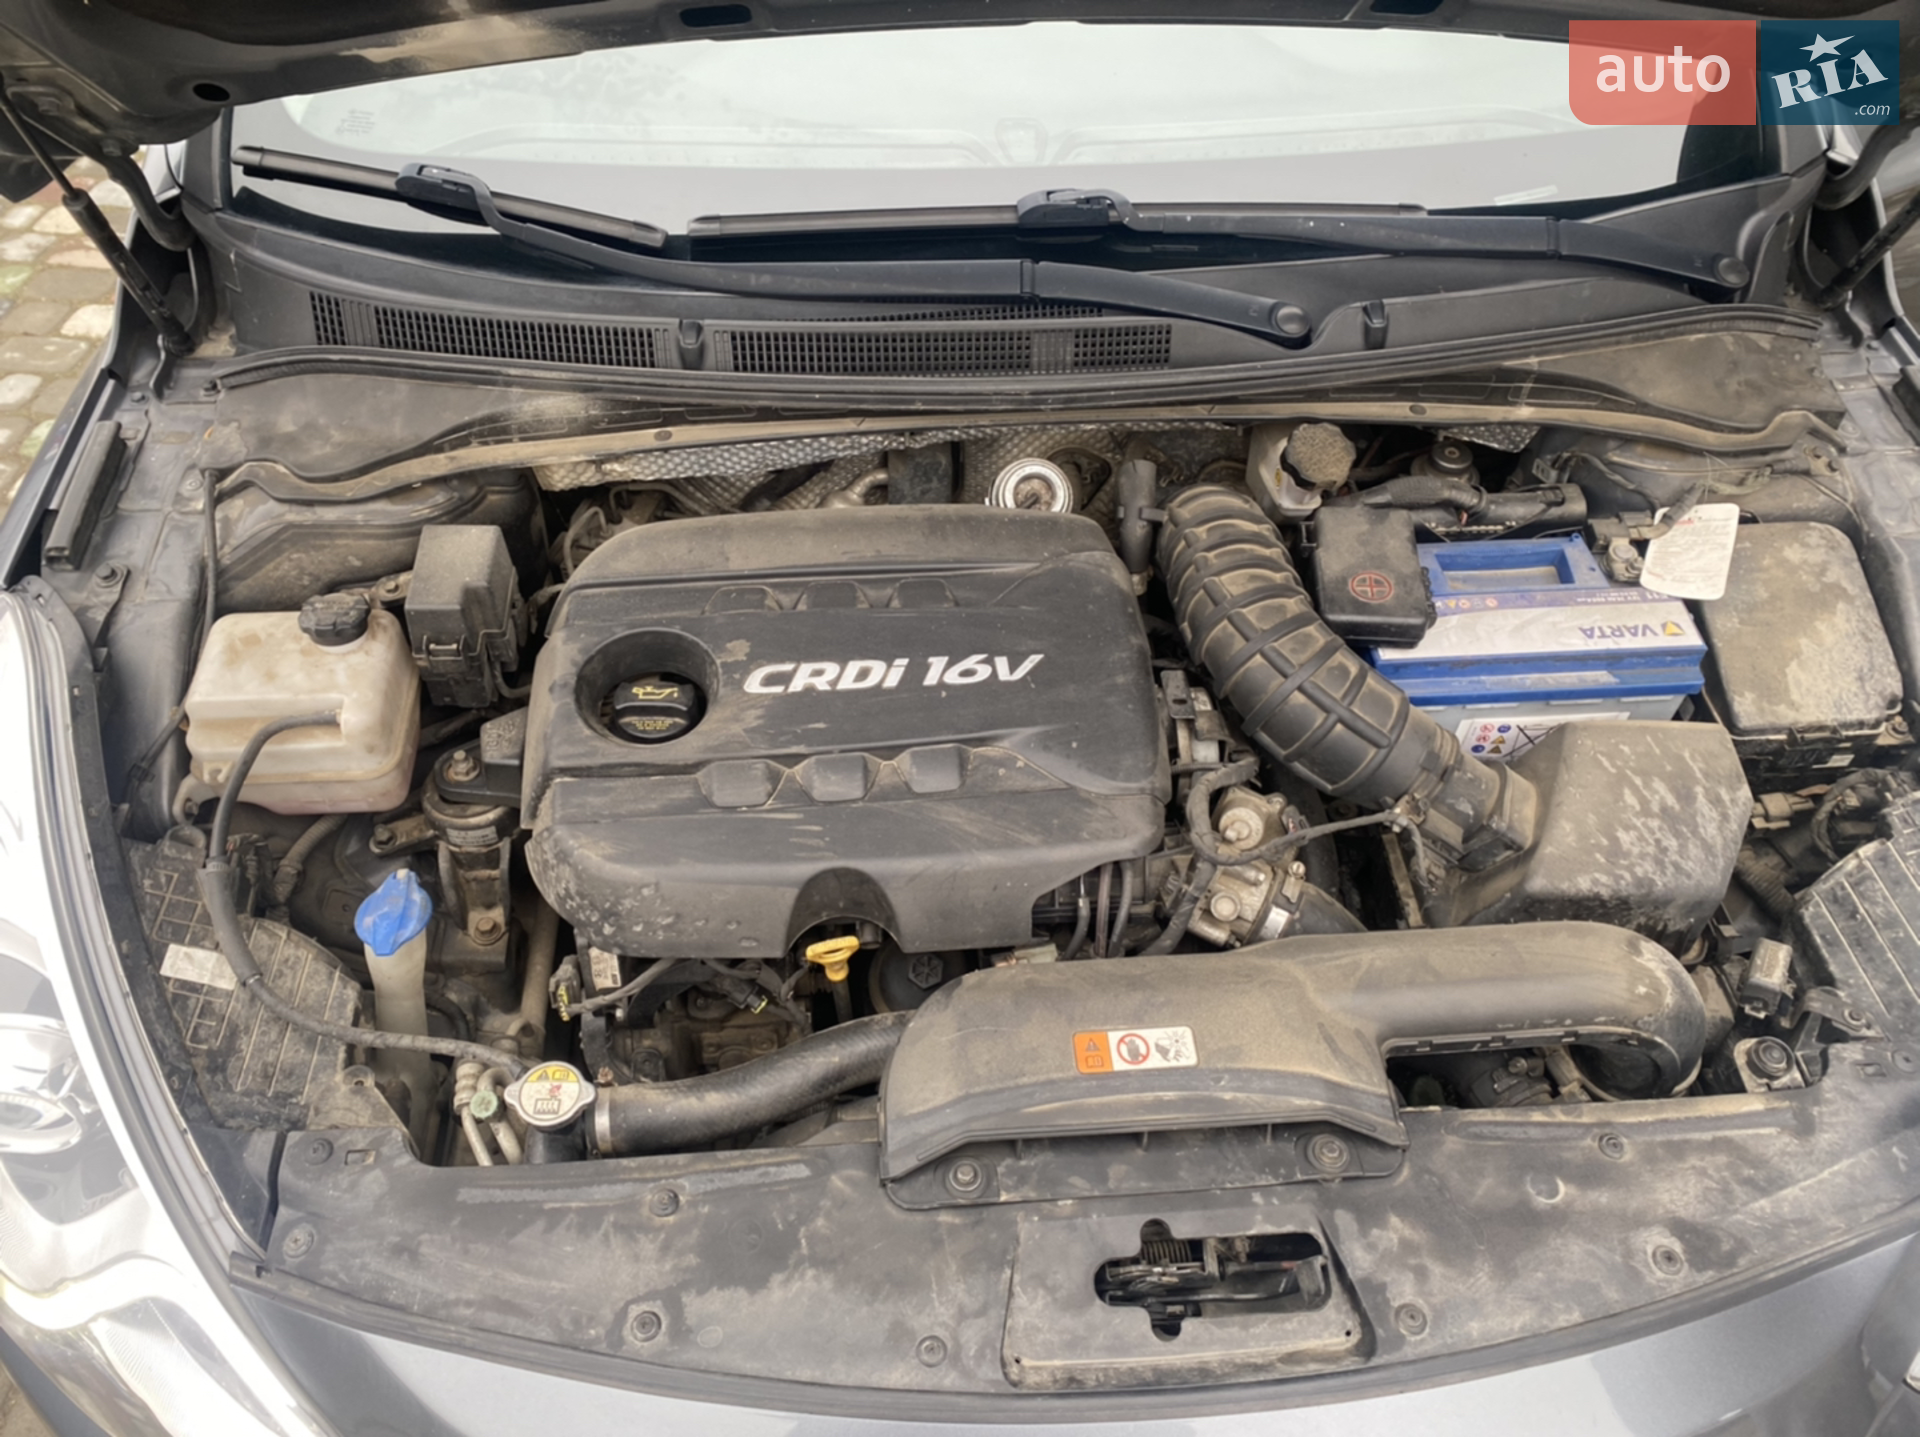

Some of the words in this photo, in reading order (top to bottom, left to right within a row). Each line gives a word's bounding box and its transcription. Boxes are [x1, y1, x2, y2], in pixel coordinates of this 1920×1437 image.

[1578, 623, 1660, 640] VARTA
[742, 657, 910, 695] CRDi
[922, 653, 1045, 687] 16V
